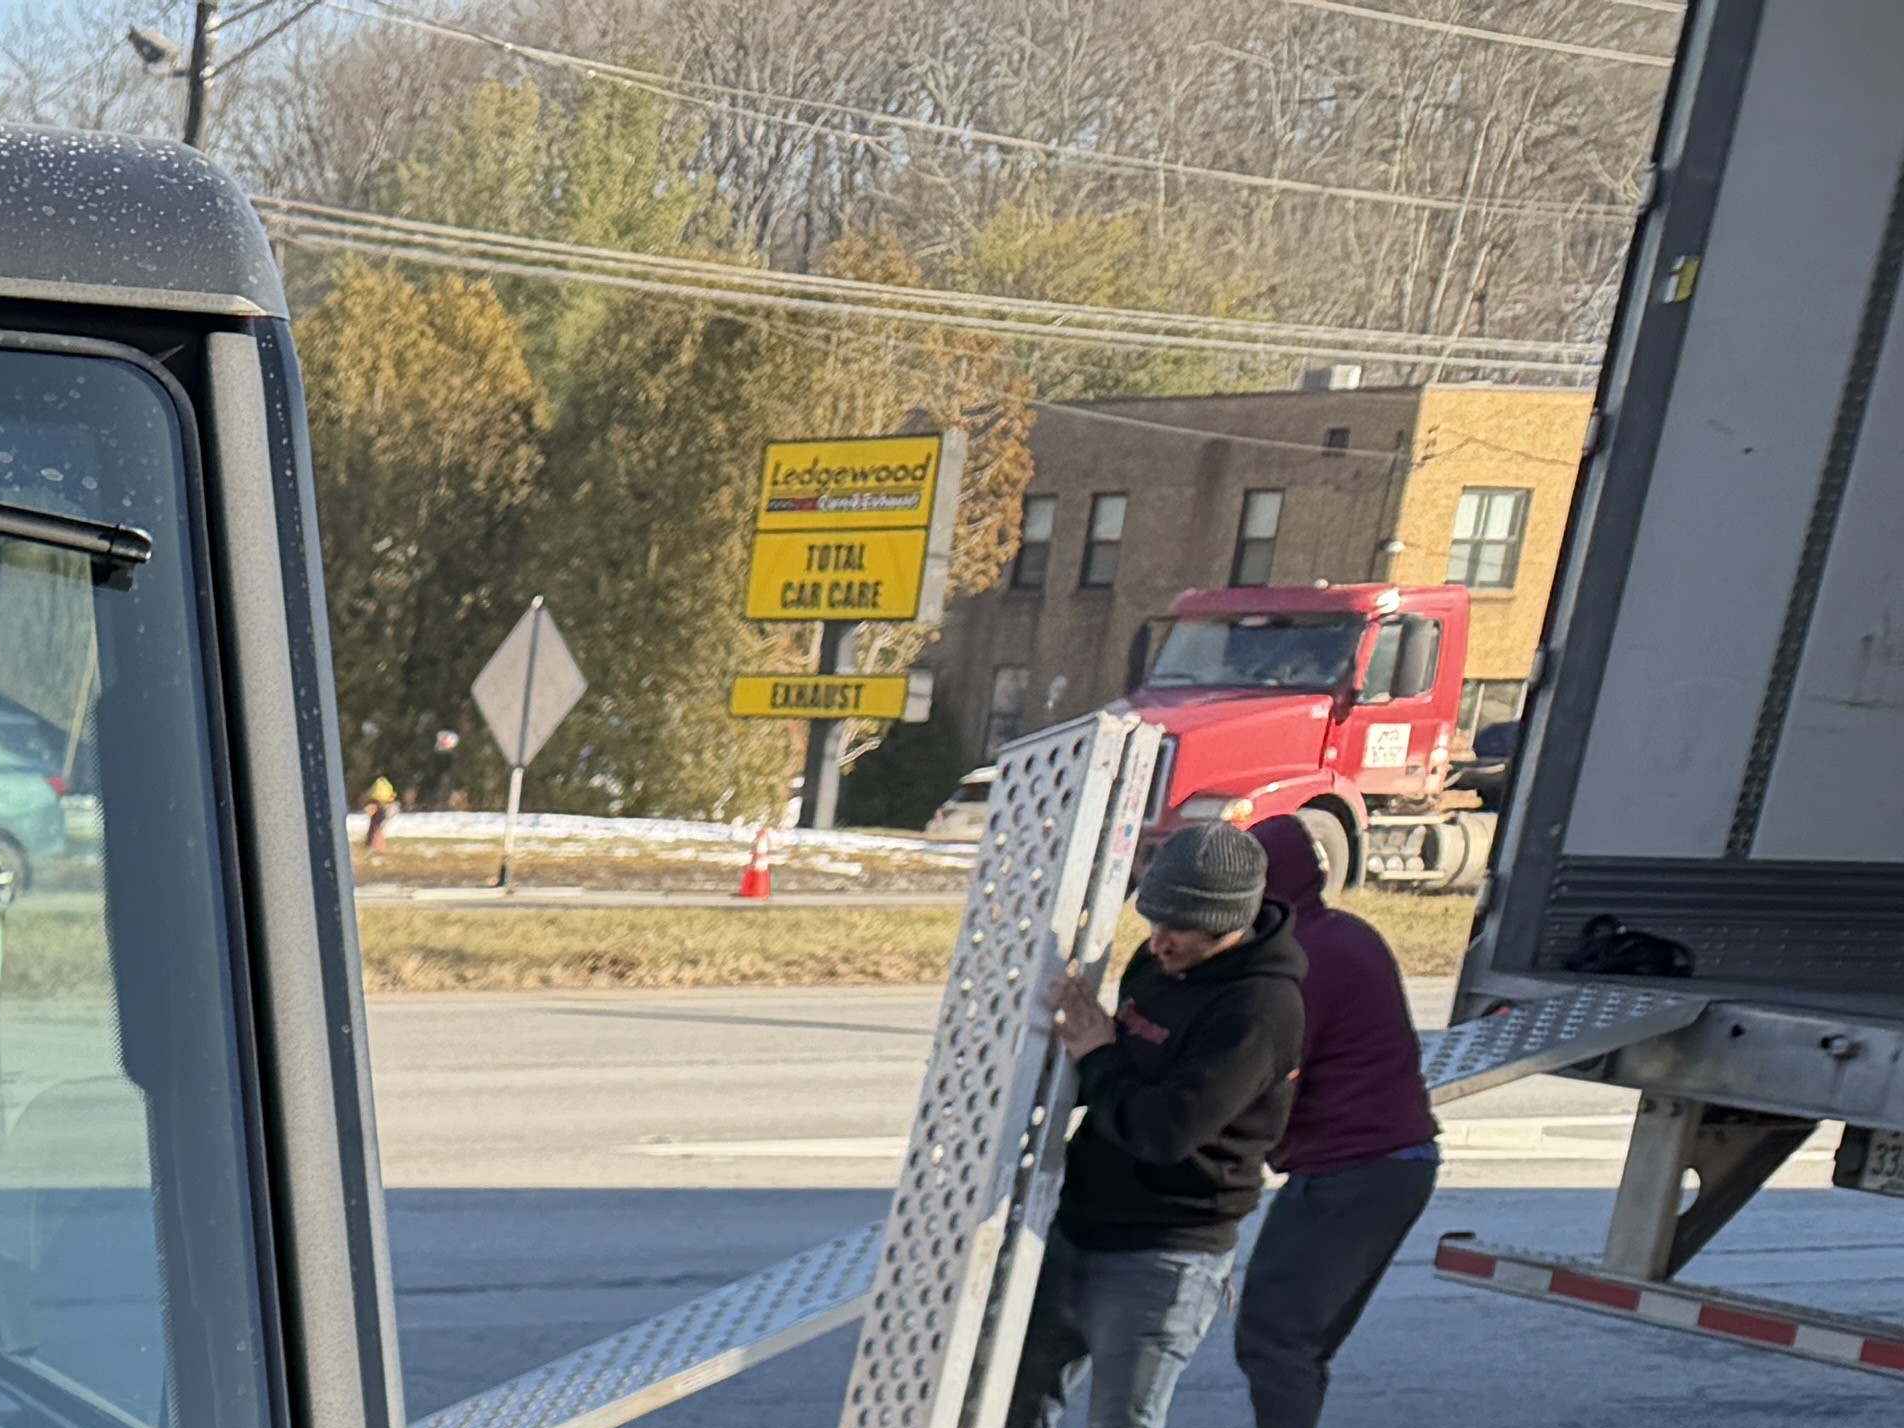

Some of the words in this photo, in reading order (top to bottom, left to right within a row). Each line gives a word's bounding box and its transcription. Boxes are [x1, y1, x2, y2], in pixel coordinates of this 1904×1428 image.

[771, 451, 933, 493] Ledgewood
[805, 543, 866, 573] TOTAL
[780, 580, 822, 610] CAR
[827, 580, 884, 609] CARE
[769, 682, 866, 711] EXHAUST
